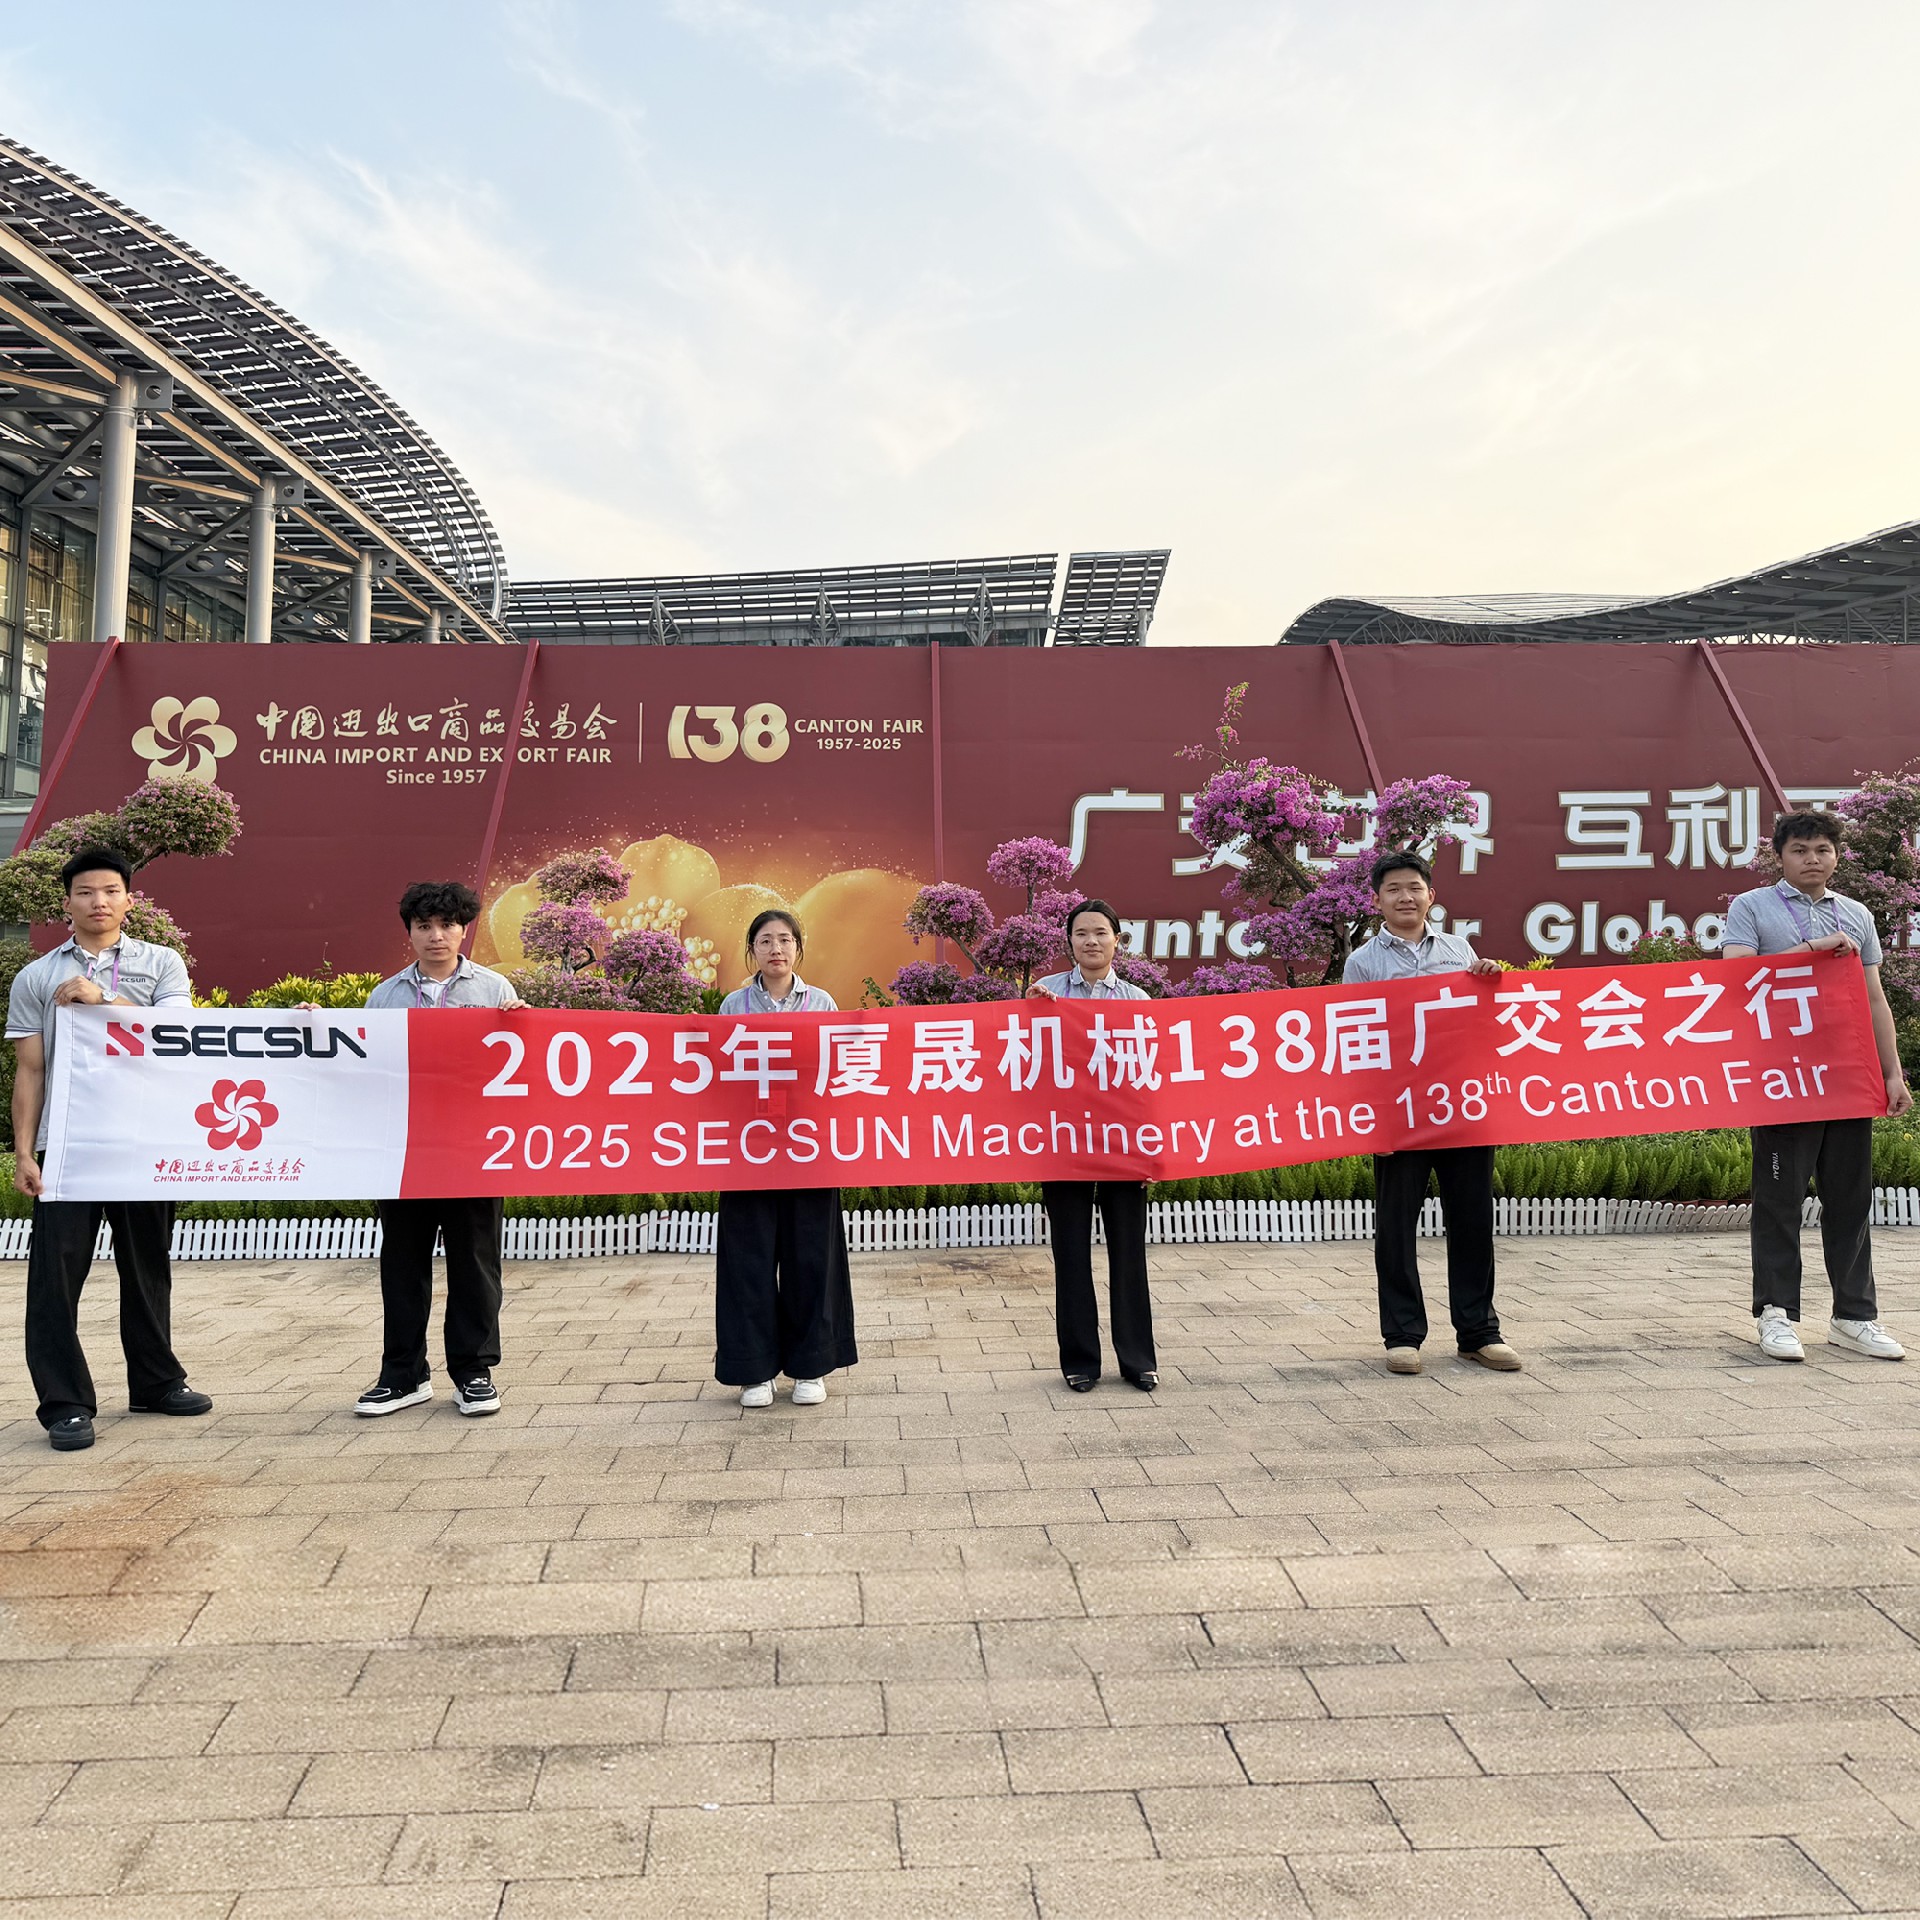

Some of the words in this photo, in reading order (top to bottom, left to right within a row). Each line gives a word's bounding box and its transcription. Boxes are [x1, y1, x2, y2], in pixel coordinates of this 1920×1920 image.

[667, 702, 790, 763] 138
[794, 719, 873, 733] CANTON
[883, 719, 924, 733] FAIR
[816, 737, 902, 750] 1957-2025
[259, 748, 327, 764] CHINA
[335, 747, 418, 764] IMPORT
[425, 747, 472, 763] AND
[479, 747, 559, 763] EXORT
[566, 747, 612, 763] FAIR
[386, 769, 435, 784] Since
[442, 769, 487, 784] 1957
[1117, 910, 1284, 959] anto
[1523, 900, 1730, 955] Globa
[151, 1024, 368, 1059] SECSUN
[481, 964, 1819, 1099] 2025年厦晟机械138届广交会之行
[481, 1123, 630, 1170] 2025
[651, 1115, 911, 1167] SECSUN
[932, 1110, 1216, 1164] Machinery
[1233, 1103, 1283, 1148] at
[1295, 1096, 1376, 1141] the
[1519, 1071, 1709, 1117] Canton
[1721, 1056, 1828, 1104] Fair
